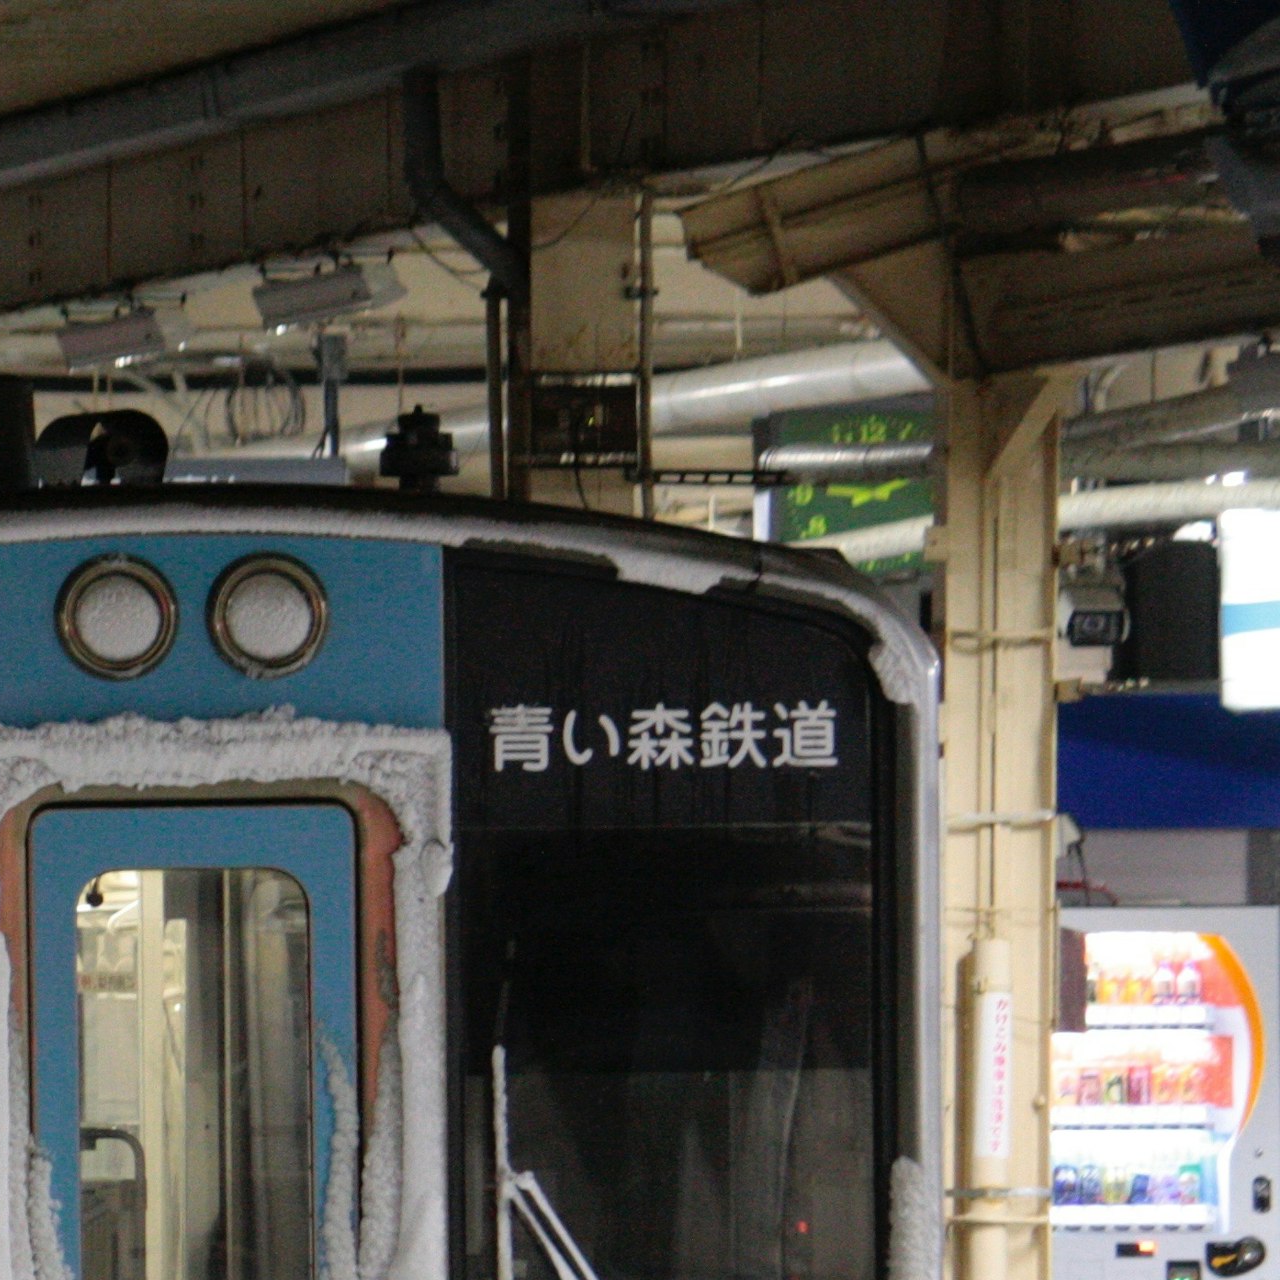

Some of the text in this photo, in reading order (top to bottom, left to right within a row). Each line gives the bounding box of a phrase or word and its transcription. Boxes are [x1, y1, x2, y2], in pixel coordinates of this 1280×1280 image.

[488, 699, 840, 772] 青い森鉄道
